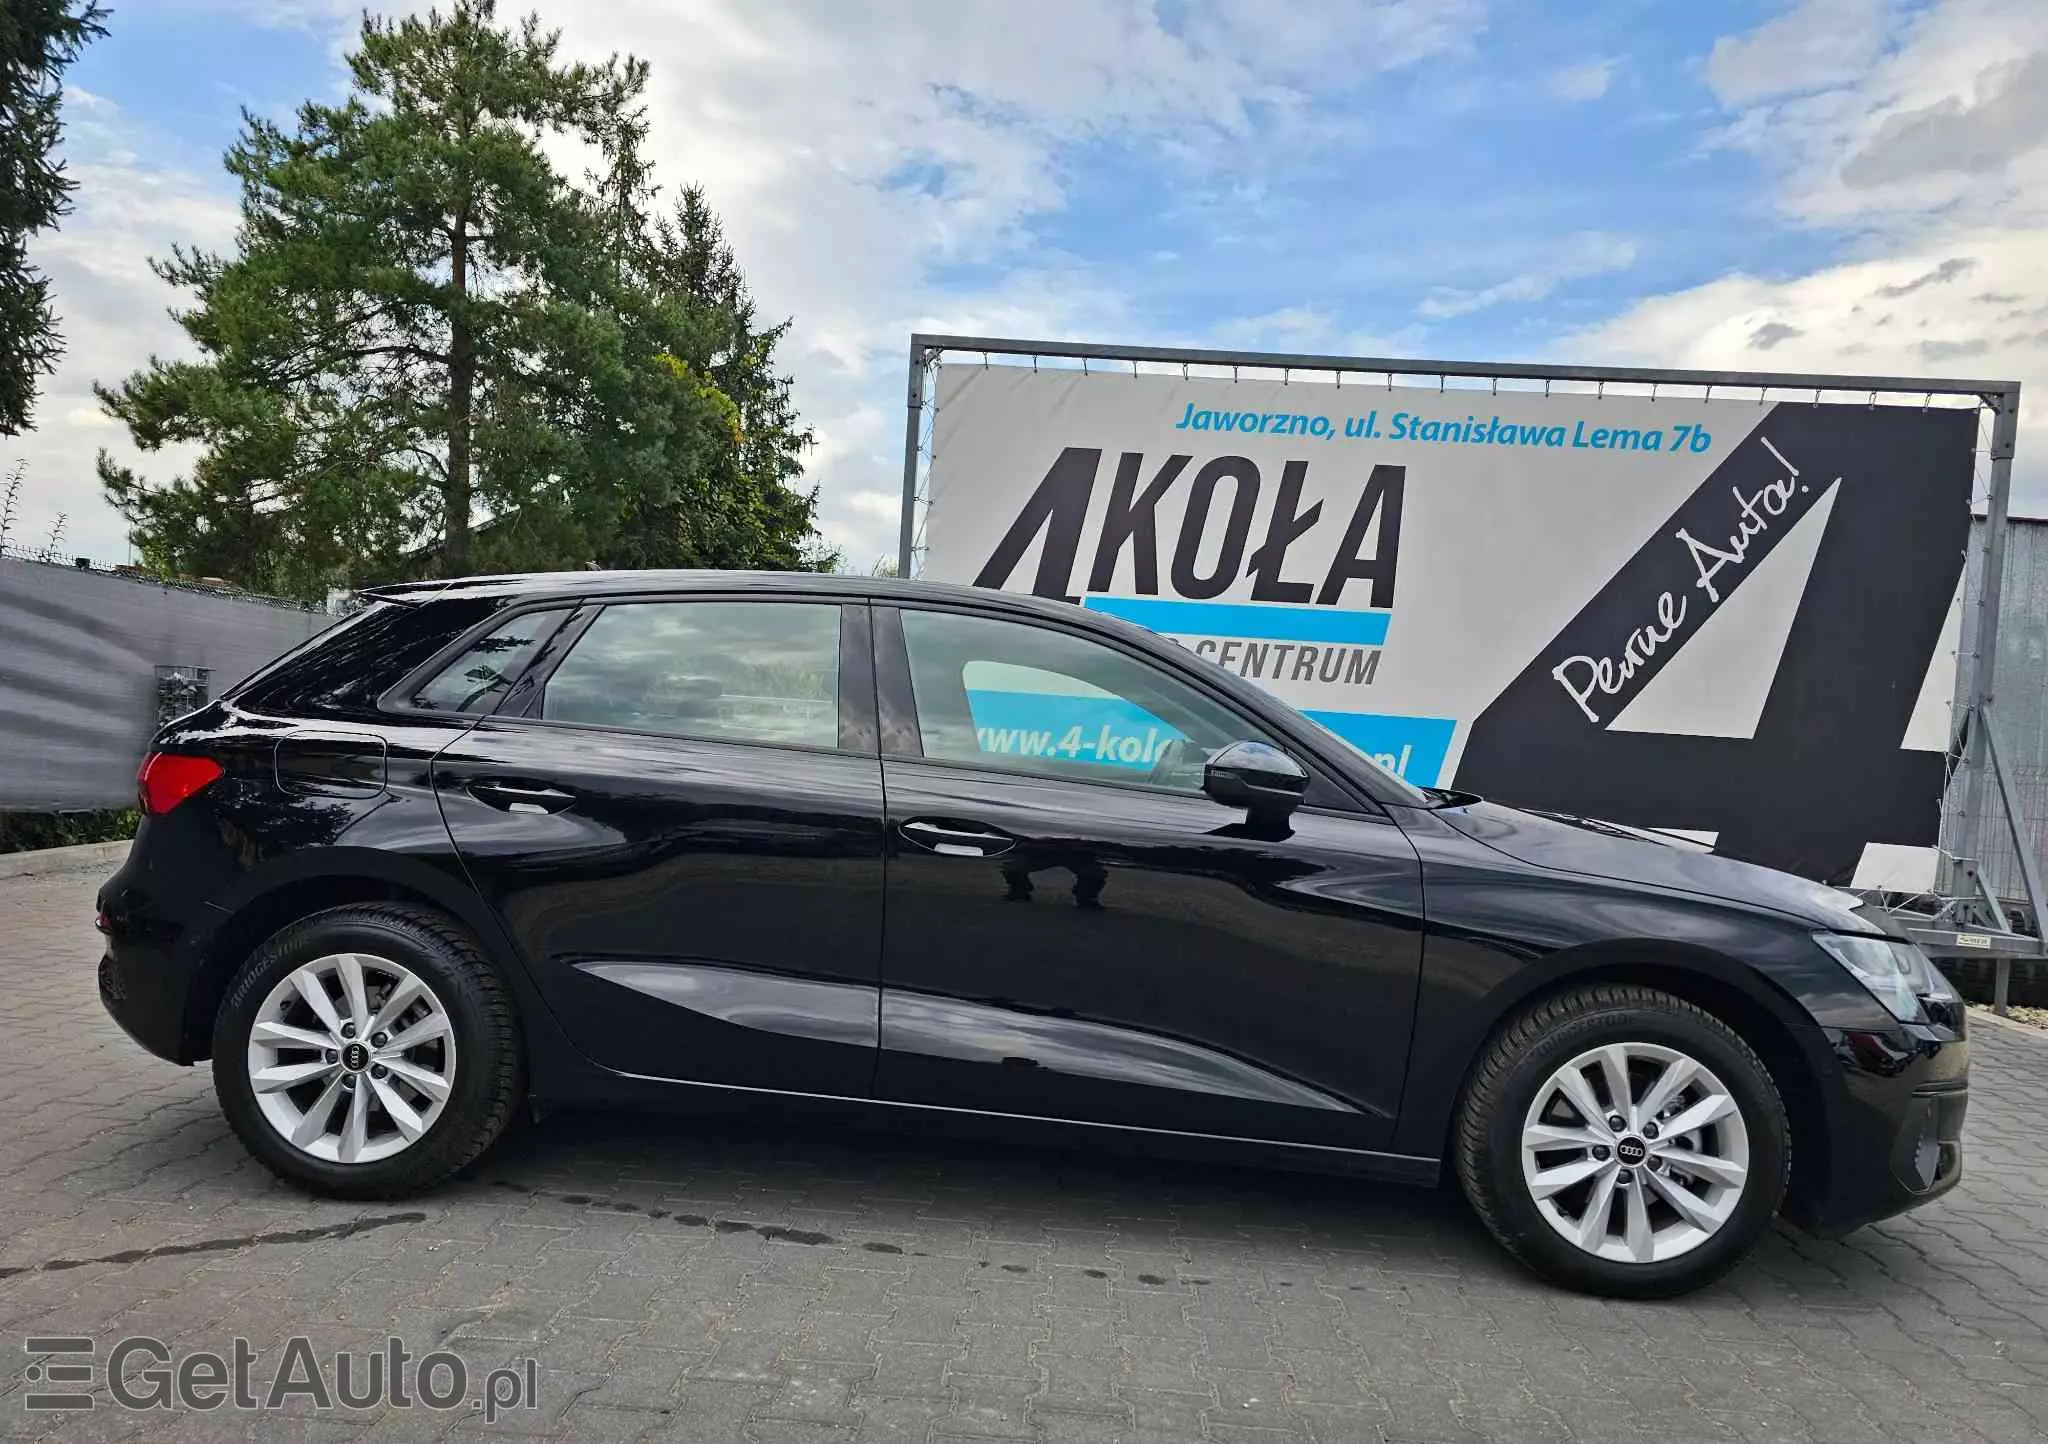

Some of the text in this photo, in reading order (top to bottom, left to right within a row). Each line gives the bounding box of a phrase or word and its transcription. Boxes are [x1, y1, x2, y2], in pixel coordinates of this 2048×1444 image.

[1175, 402, 1712, 454] Jaworzno, ul. Stanisława Lema 7b
